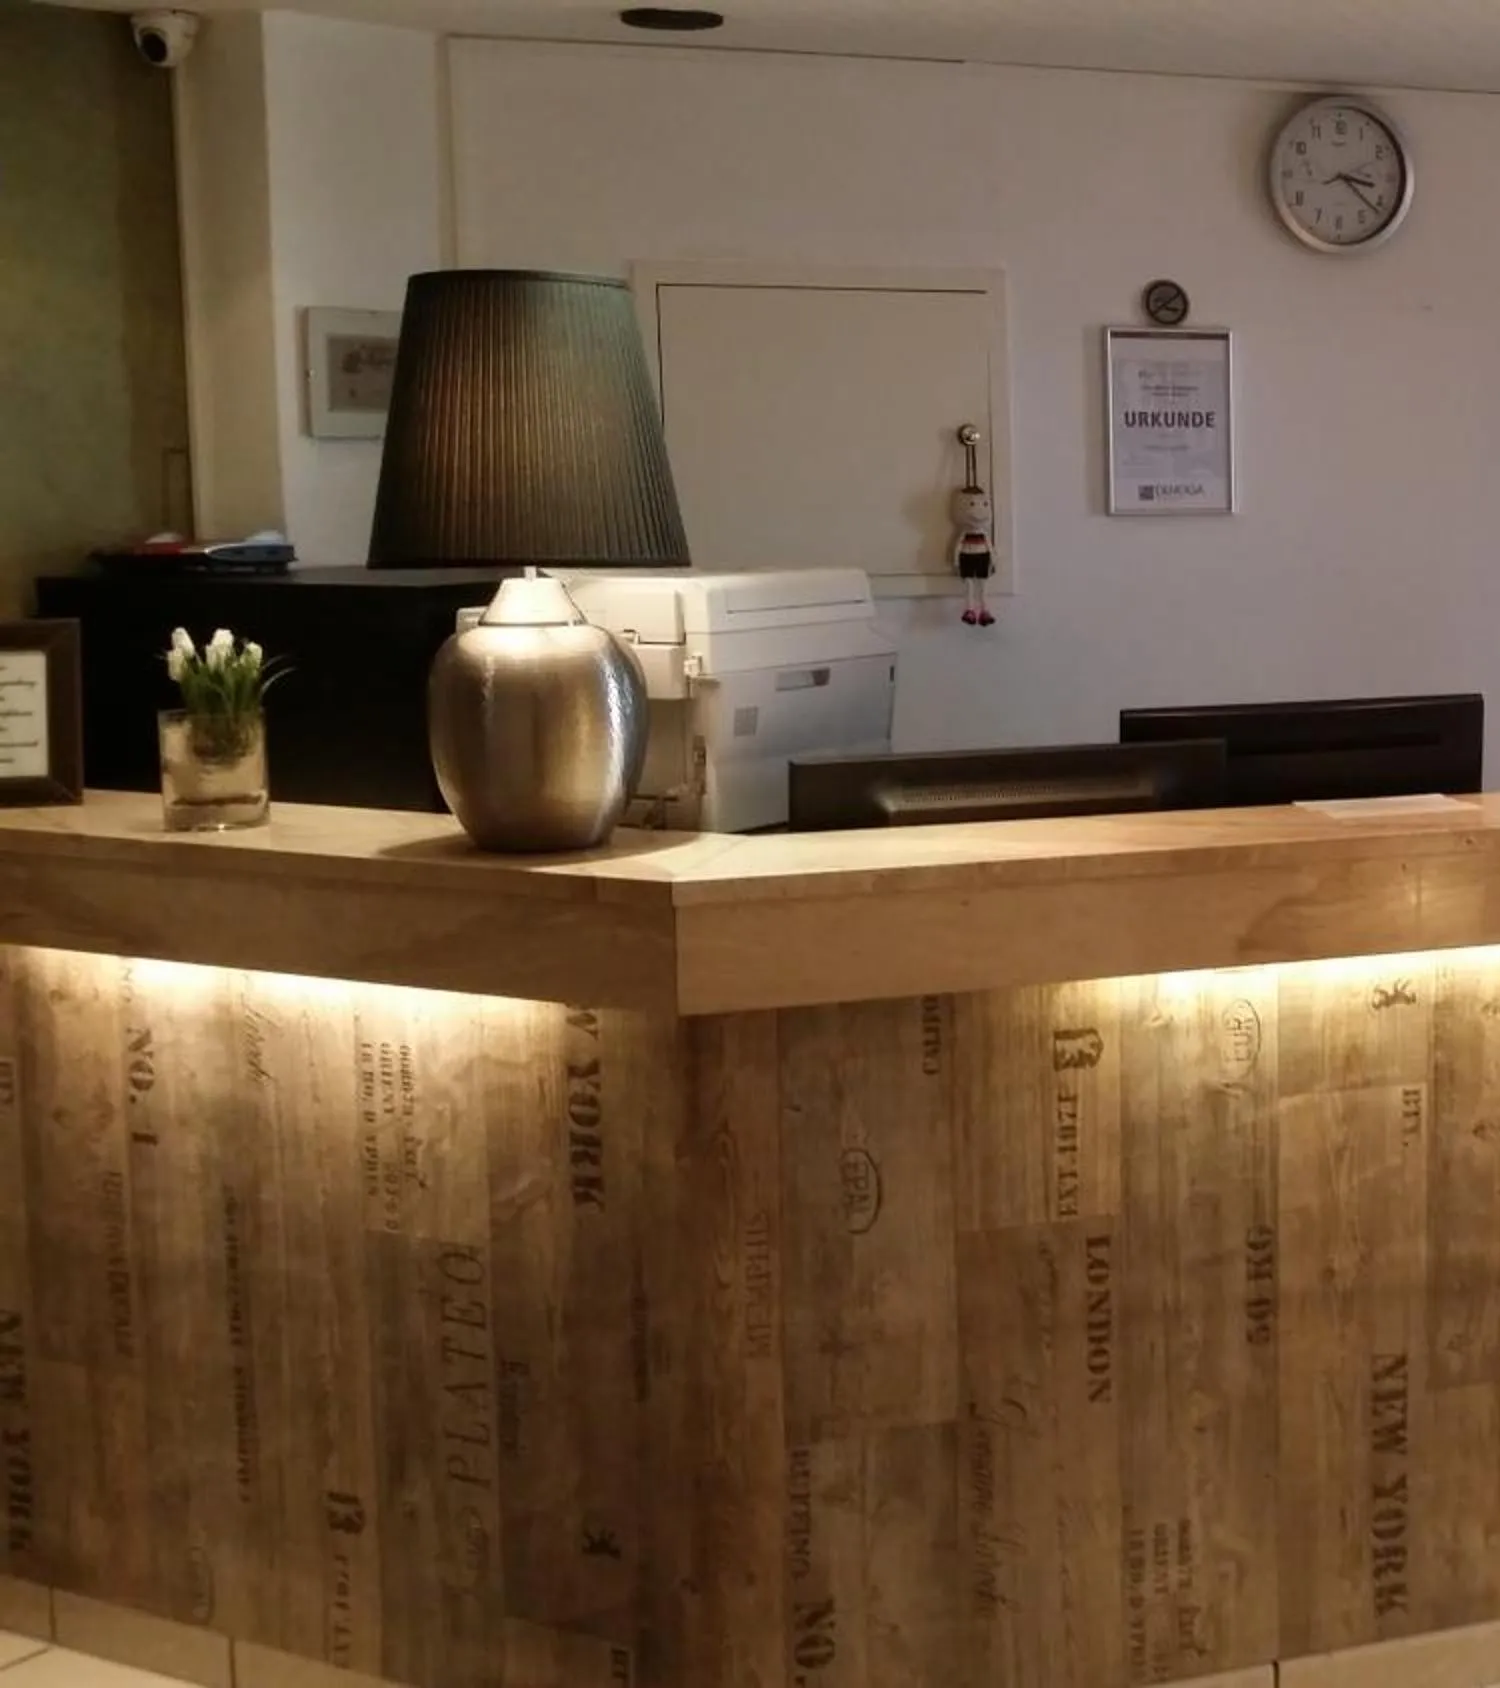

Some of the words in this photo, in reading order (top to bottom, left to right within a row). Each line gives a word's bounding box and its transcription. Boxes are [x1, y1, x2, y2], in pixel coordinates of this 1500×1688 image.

[1124, 411, 1216, 428] URKUNDE
[127, 1027, 156, 1104] NO.
[568, 1057, 605, 1212] YORK
[1245, 1224, 1275, 1284] KG
[441, 1246, 492, 1490] PLATEO
[1086, 1233, 1113, 1404] LONDON
[1245, 1297, 1275, 1347] 50
[1371, 1353, 1409, 1456] NEW
[1371, 1473, 1410, 1619] YORK
